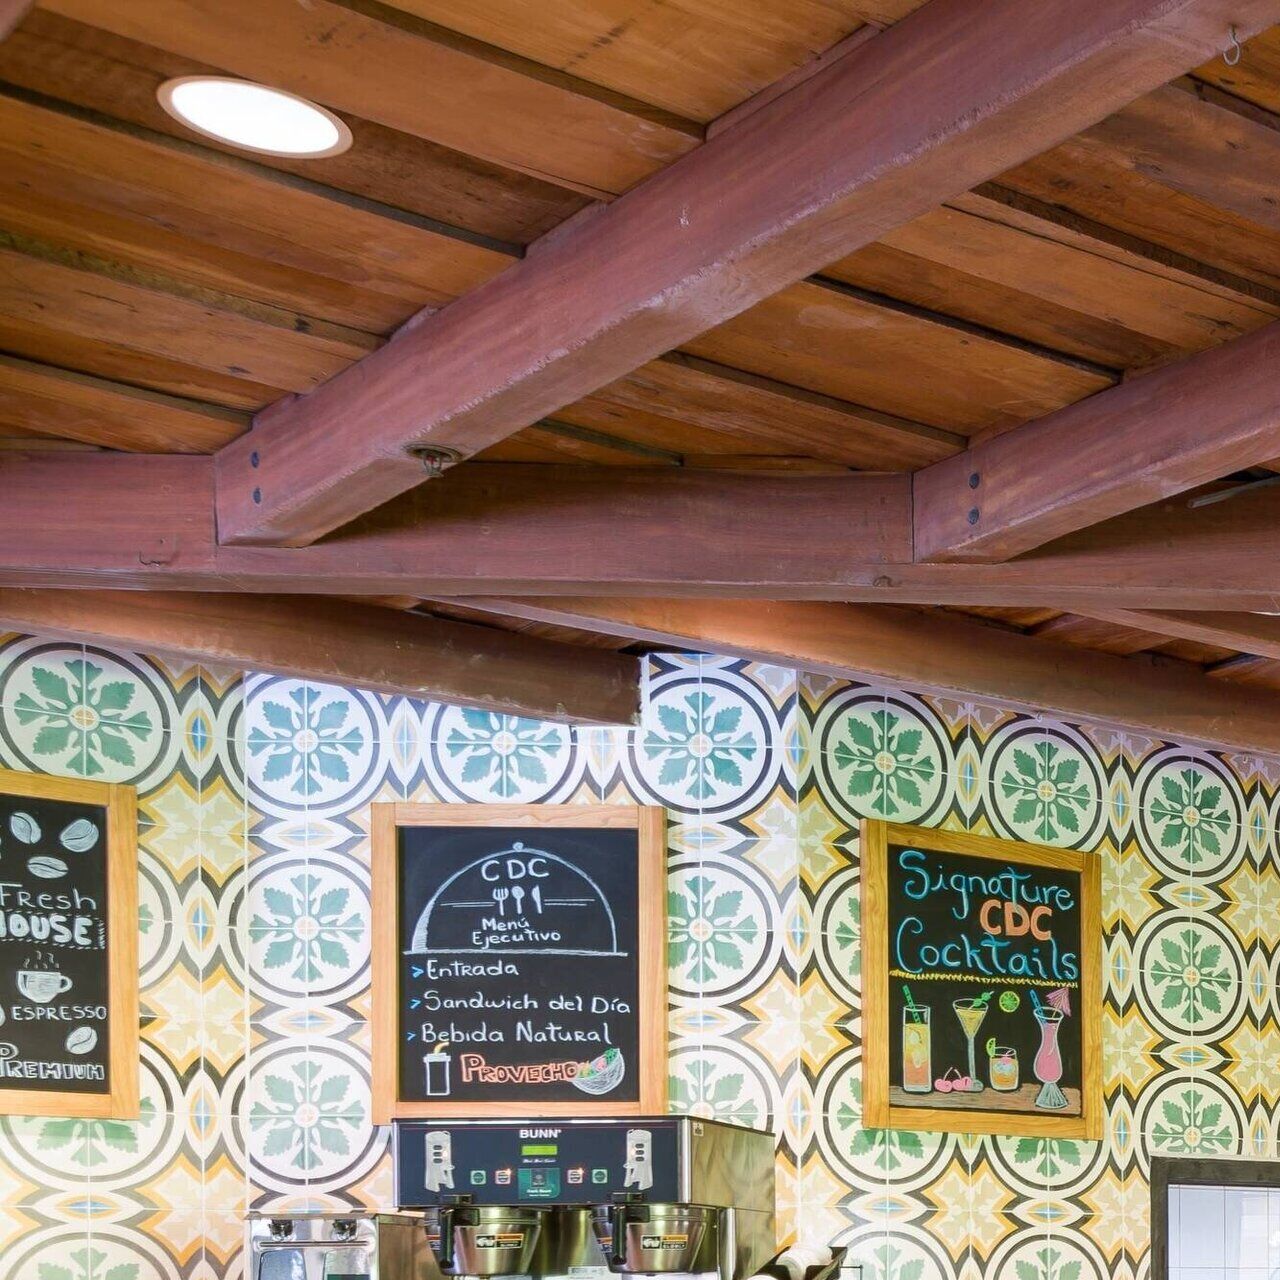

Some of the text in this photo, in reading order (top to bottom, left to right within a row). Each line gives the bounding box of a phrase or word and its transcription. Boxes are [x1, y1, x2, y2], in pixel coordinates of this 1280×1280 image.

[481, 858, 549, 882] CDC
[899, 850, 1076, 920] Signature
[0, 910, 94, 946] OUSE
[482, 917, 530, 932] Menú
[979, 899, 1053, 941] CDC
[472, 930, 562, 950] Ejecutivo
[896, 917, 1079, 981] Cocktails
[426, 959, 520, 980] Entrada
[11, 1005, 108, 1021] ESPRESSO
[423, 990, 631, 1014] Sandwich del Día
[421, 1020, 613, 1045] Bebida Natural
[519, 1128, 559, 1139] BUNN
